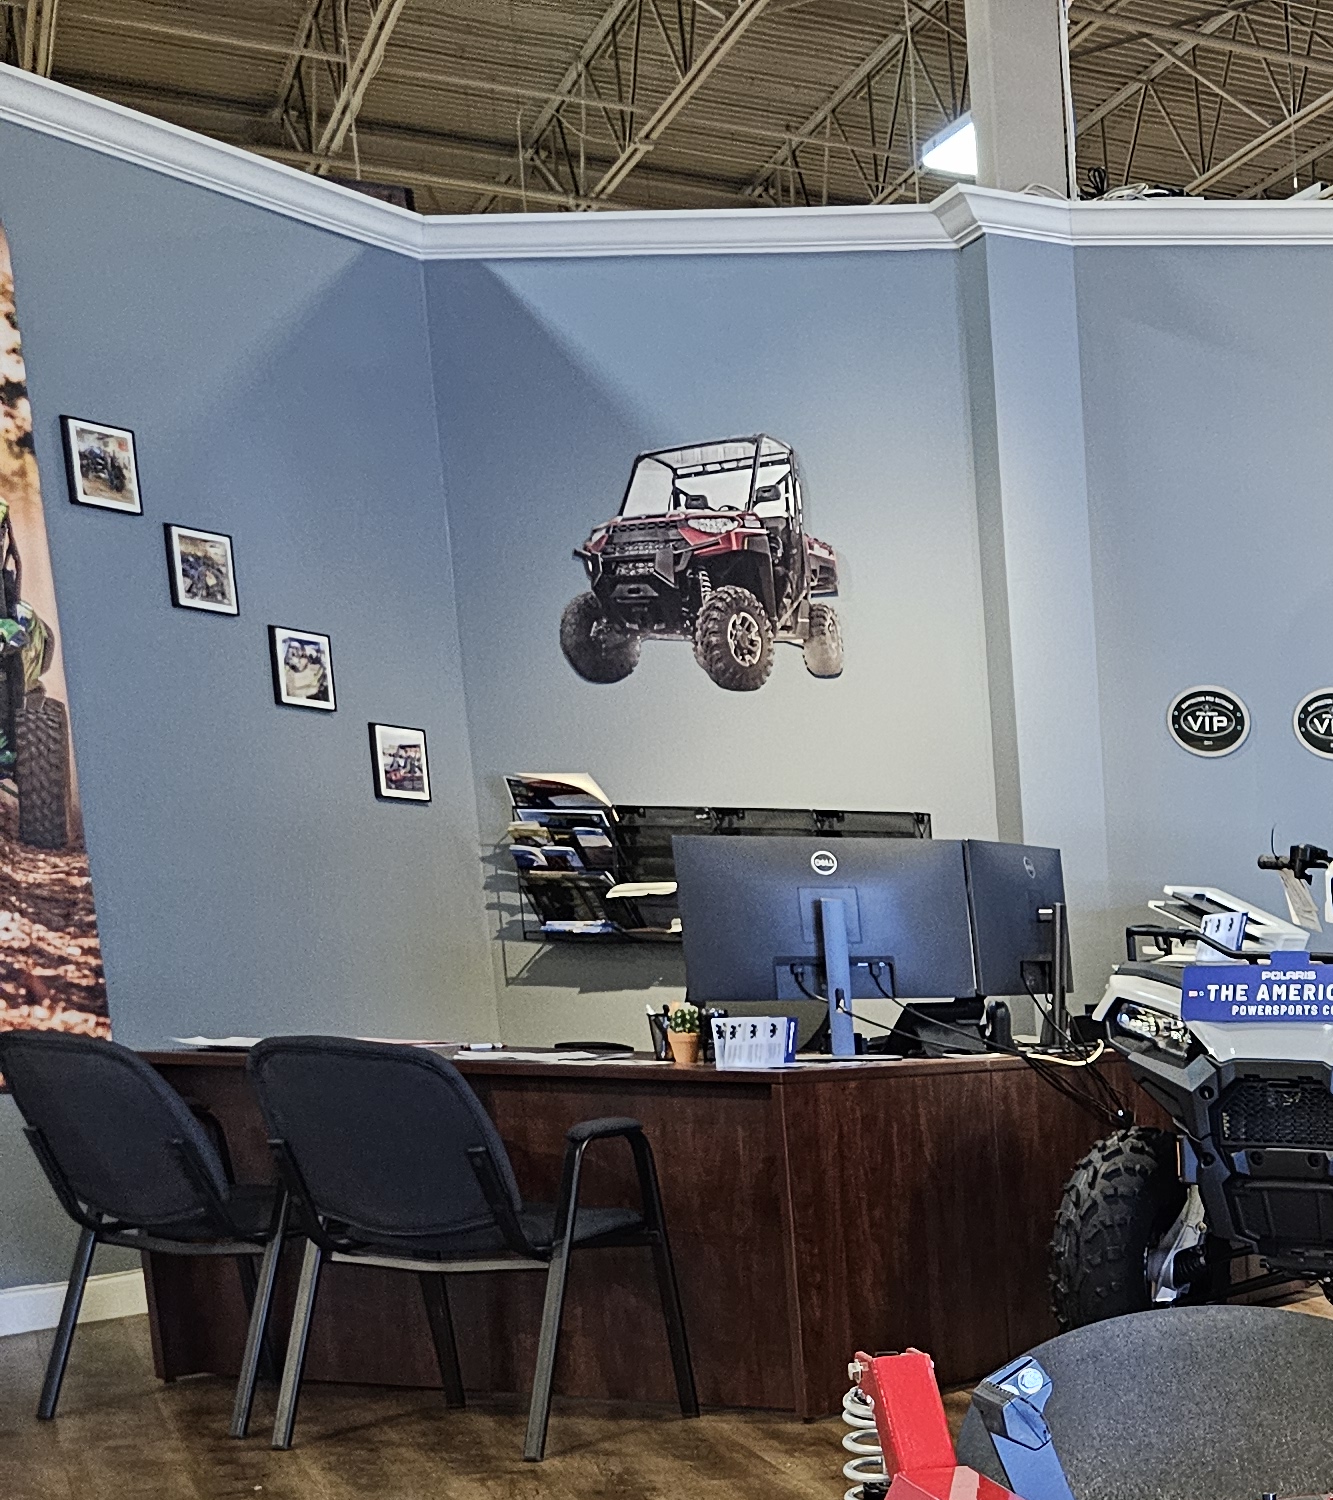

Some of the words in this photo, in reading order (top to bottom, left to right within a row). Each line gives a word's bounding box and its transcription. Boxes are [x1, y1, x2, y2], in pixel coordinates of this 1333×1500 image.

[1187, 715, 1228, 732] VIP
[1262, 971, 1317, 981] POLARIS
[1207, 984, 1249, 1001] THE
[1232, 1004, 1318, 1016] POWERSPORTS
